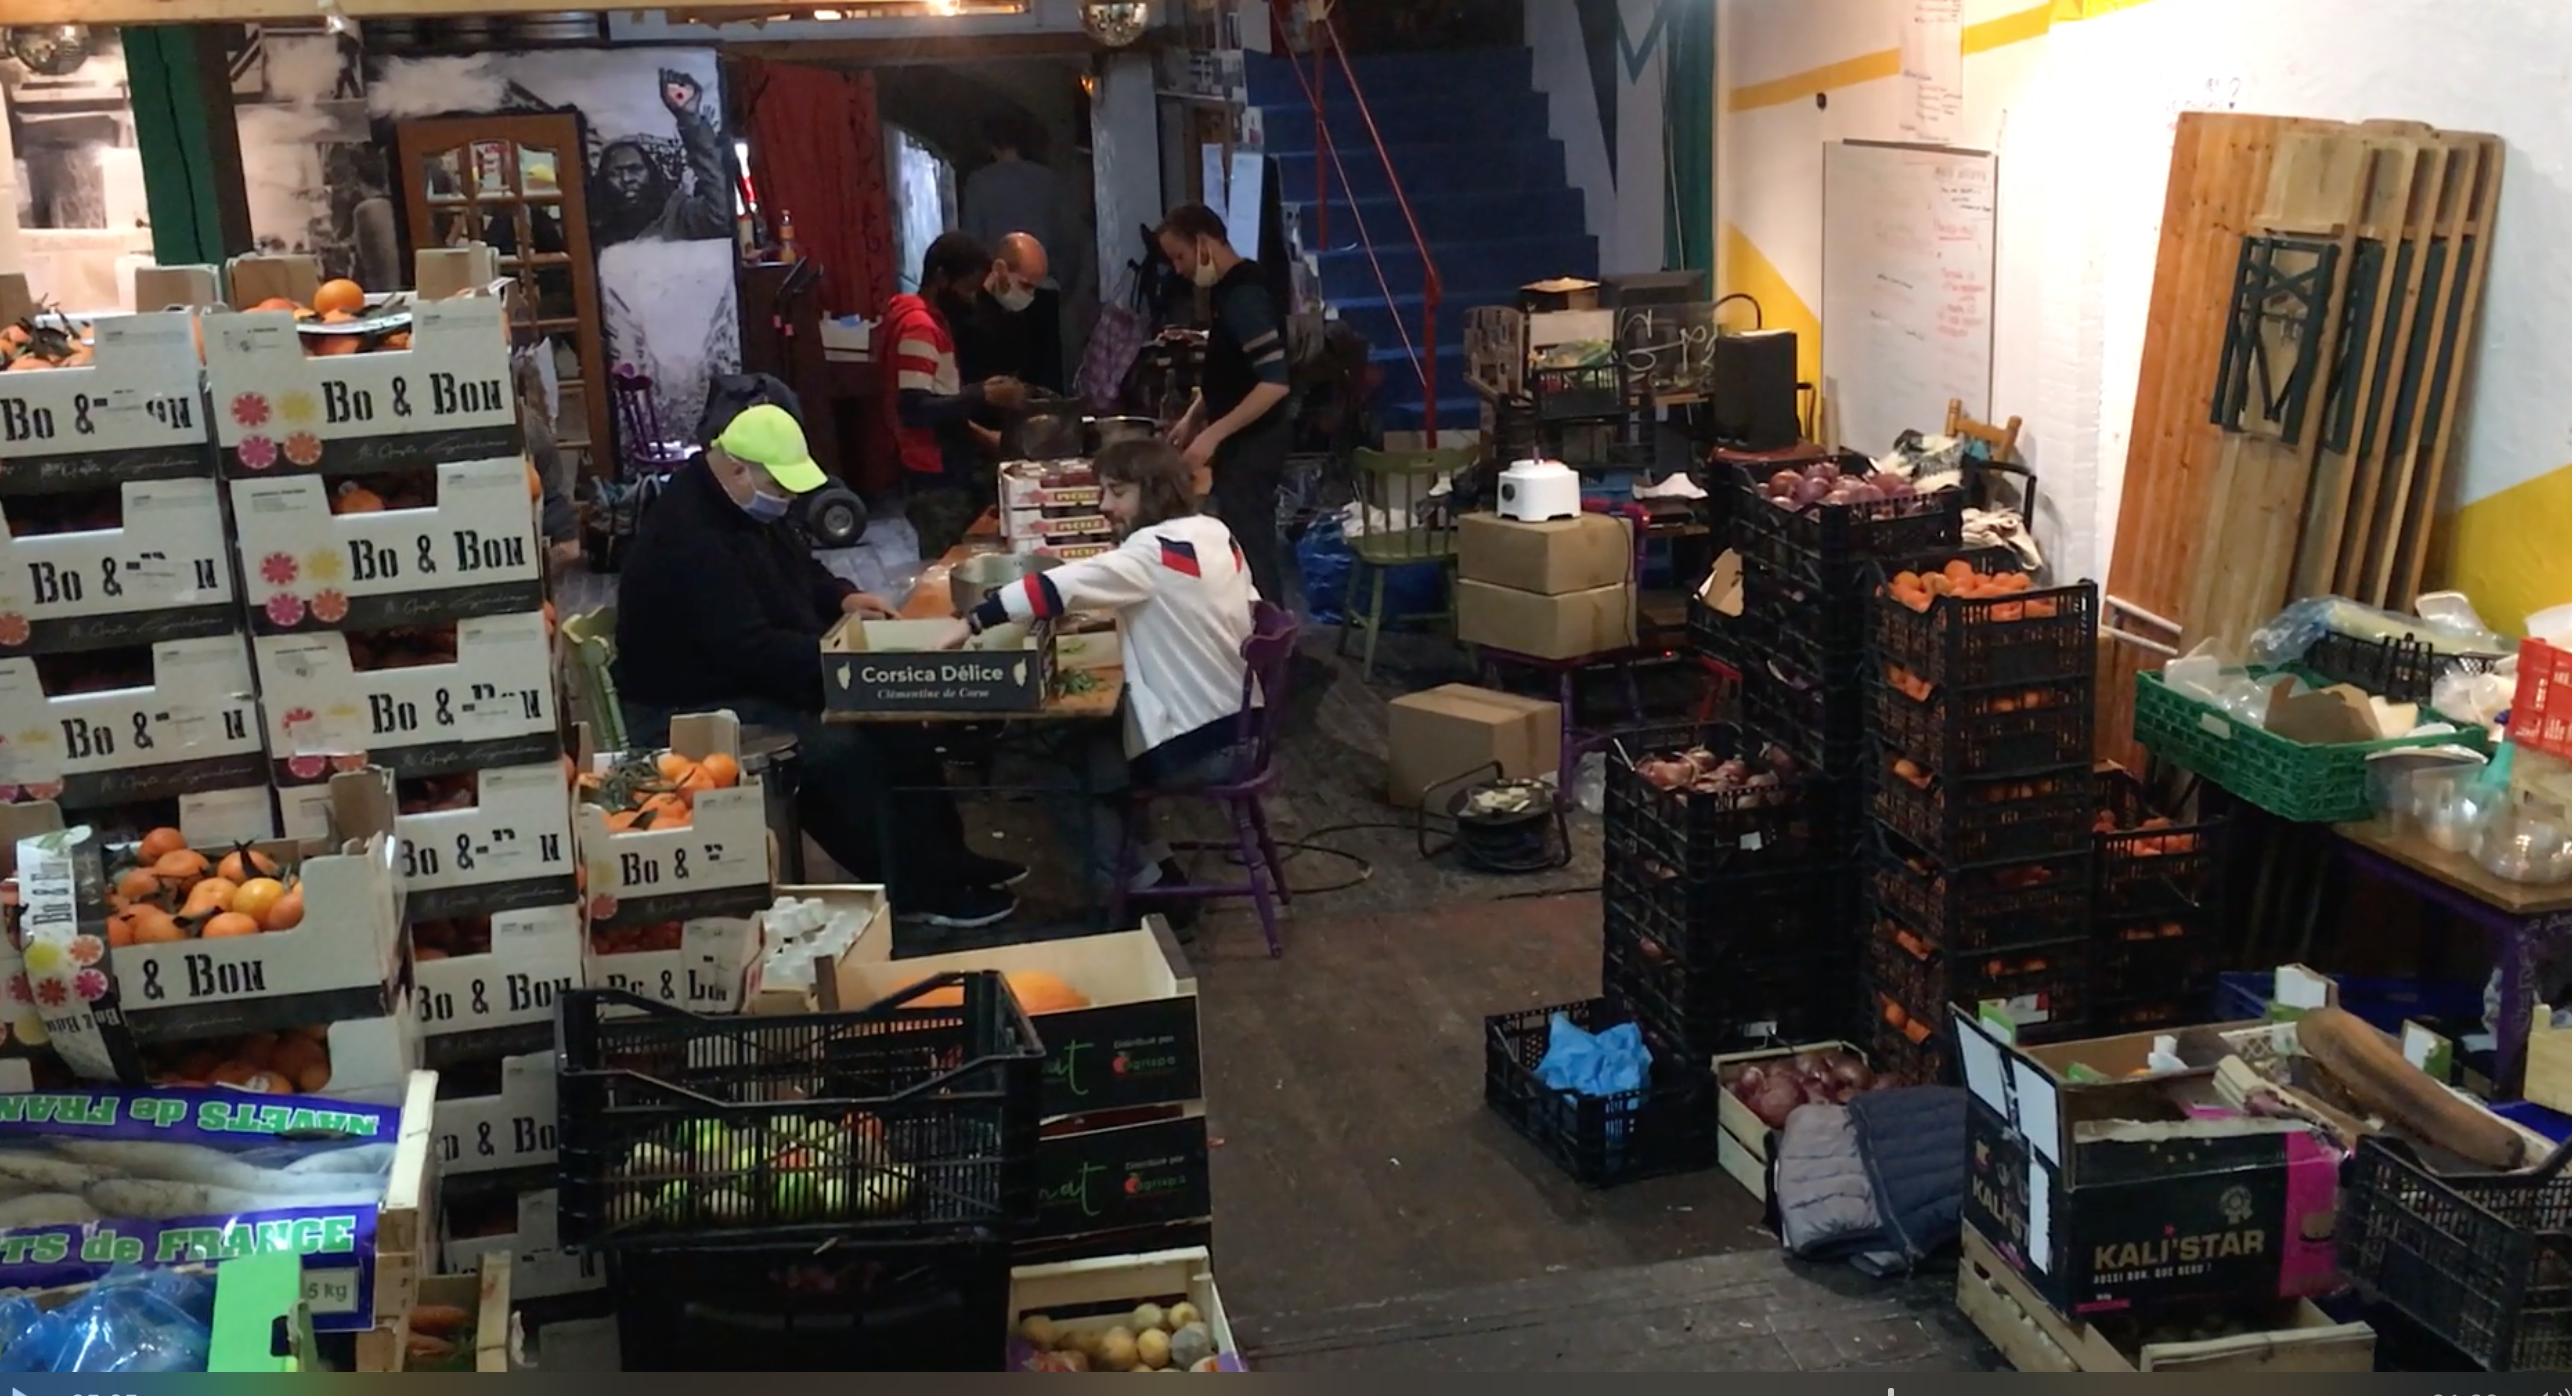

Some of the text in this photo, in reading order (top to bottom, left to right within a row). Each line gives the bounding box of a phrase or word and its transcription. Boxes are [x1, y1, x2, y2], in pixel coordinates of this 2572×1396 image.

[74, 394, 95, 434] &
[391, 376, 412, 417] &
[416, 534, 437, 574] &
[102, 557, 122, 596] &
[861, 663, 1004, 684] Corsica Délice
[435, 688, 455, 726] &
[877, 687, 990, 699] Clémentine de Corse
[132, 711, 154, 749] &
[456, 833, 475, 870] &
[674, 848, 690, 879] &
[143, 959, 165, 1000] &
[471, 979, 489, 1014] &
[660, 969, 675, 1000] &
[0, 1094, 380, 1136] NAVETS de FRAN
[477, 1121, 495, 1155] &
[80, 1228, 144, 1263] de
[155, 1215, 357, 1263] FRANCE
[2094, 1228, 2265, 1271] KALI'STAR
[323, 1282, 348, 1301] kg
